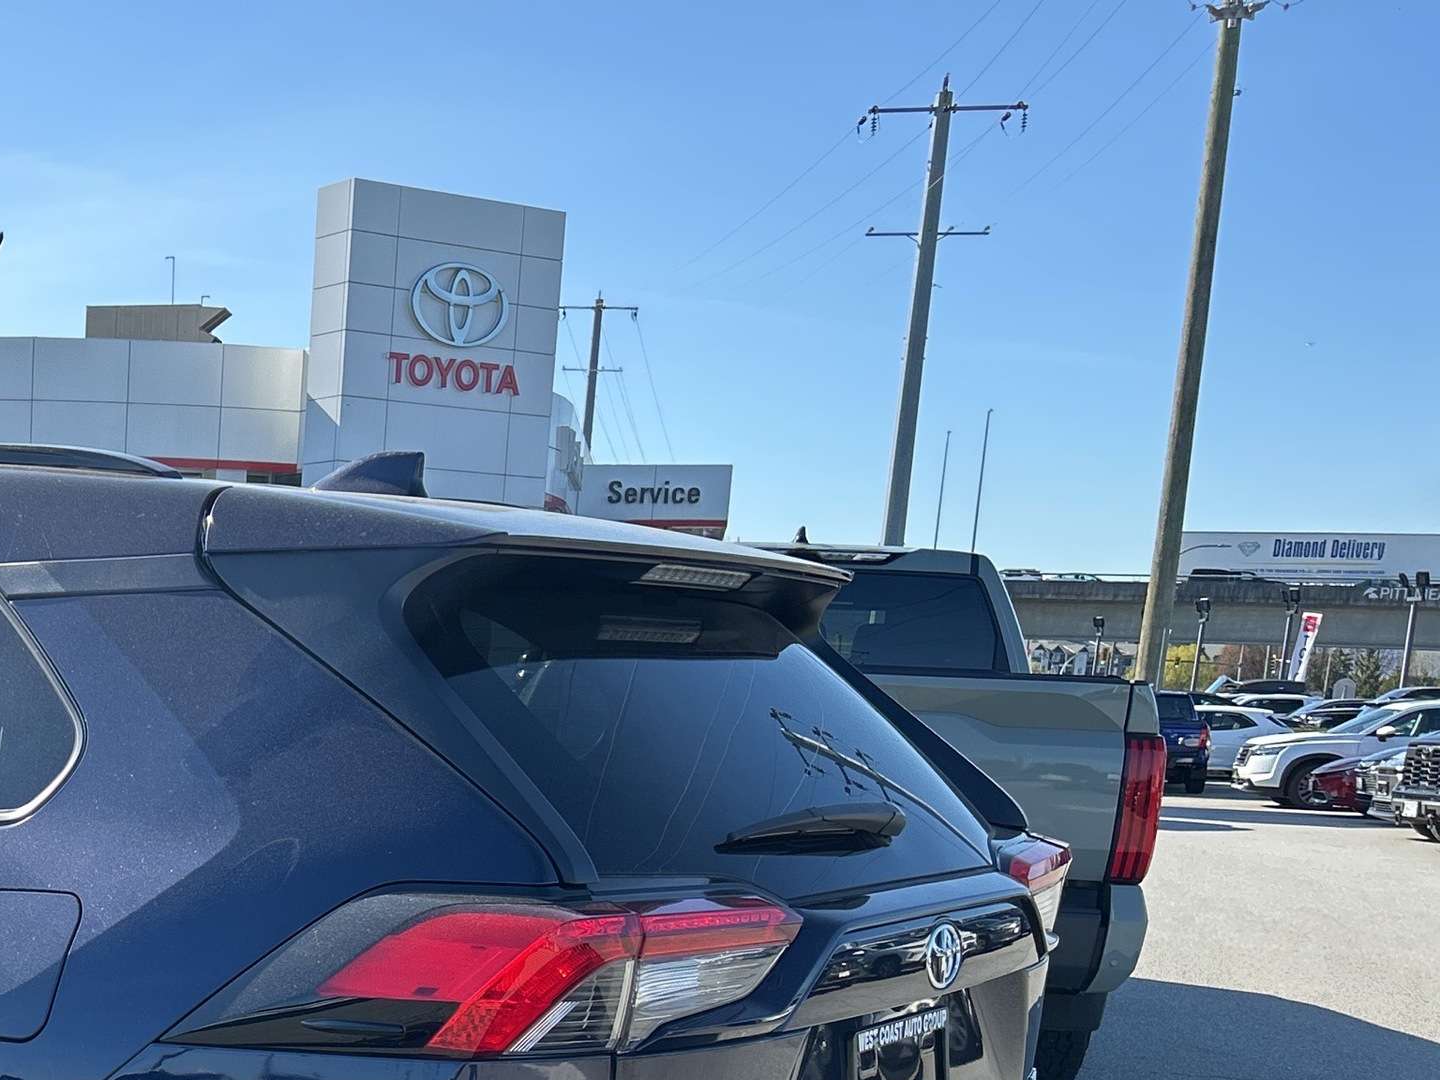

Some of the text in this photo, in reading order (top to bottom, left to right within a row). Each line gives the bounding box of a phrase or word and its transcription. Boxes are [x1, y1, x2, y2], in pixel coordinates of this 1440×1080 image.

[389, 352, 520, 396] TOYOTA
[607, 480, 701, 504] Service
[1272, 538, 1386, 561] Diamond Delivery
[858, 1009, 947, 1053] WEST COAST AUTO GROUP
